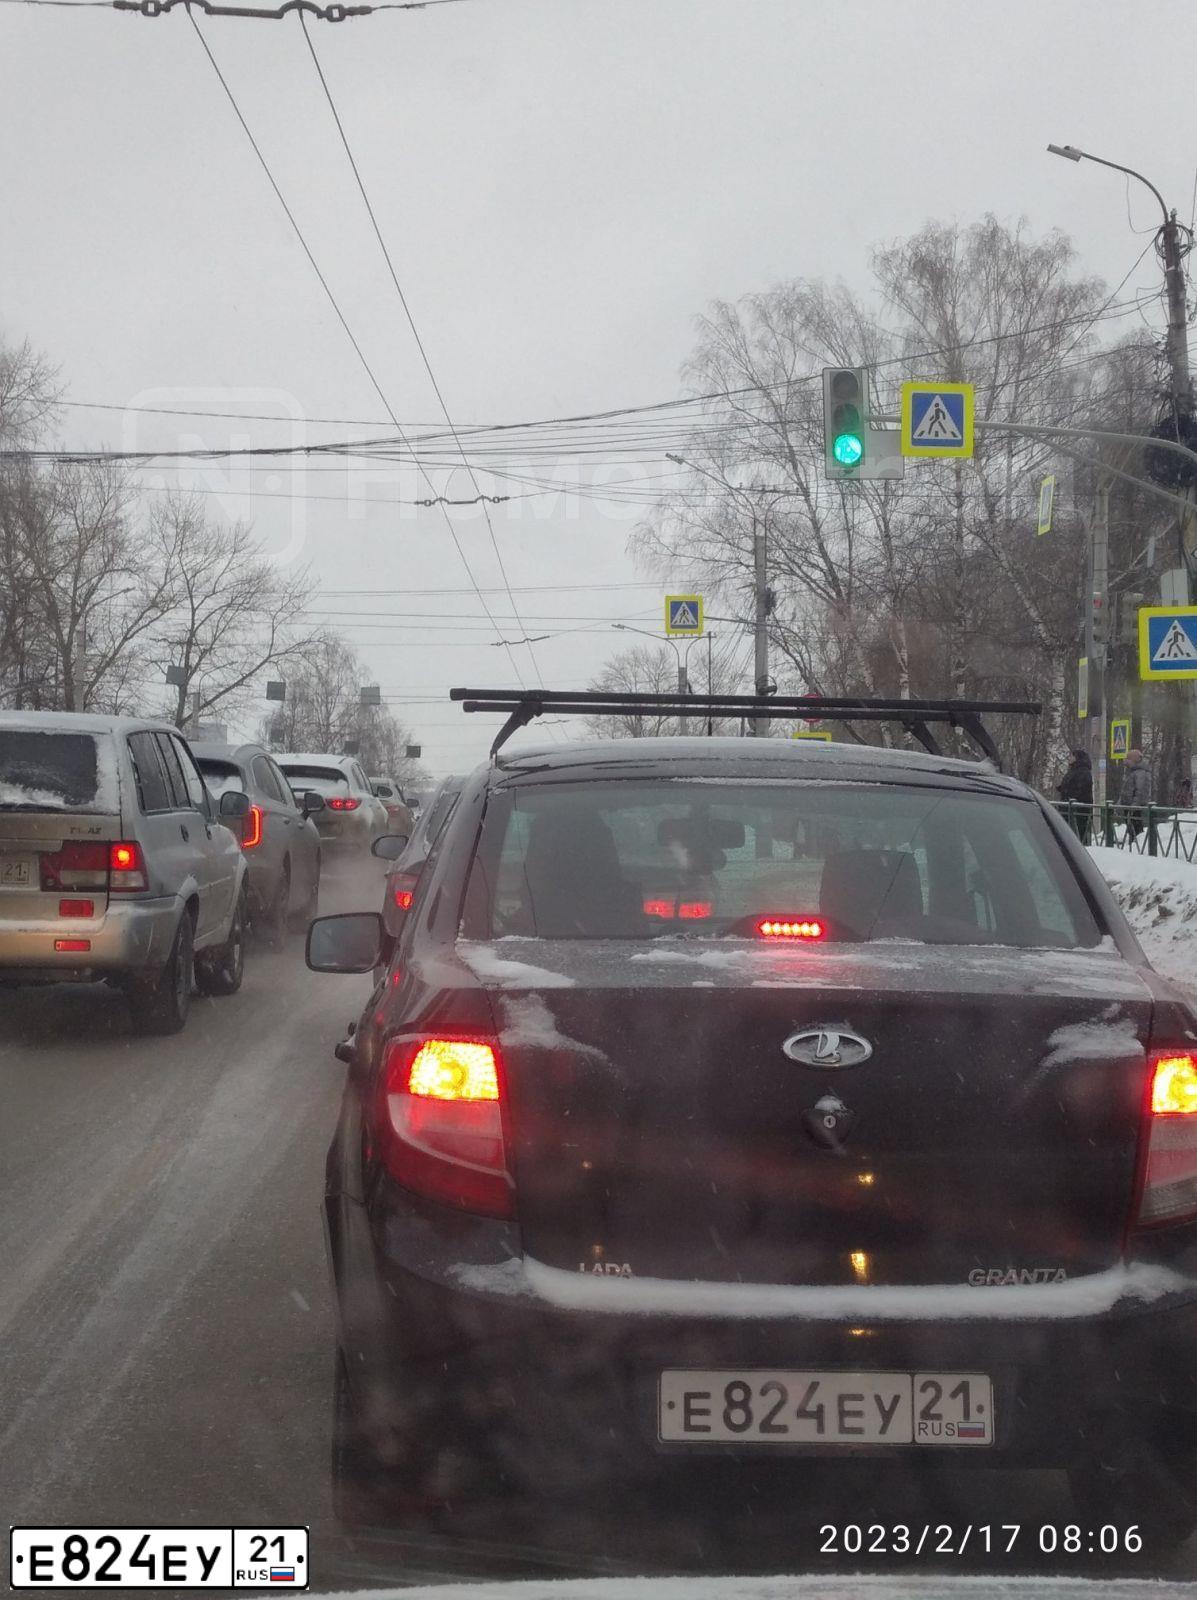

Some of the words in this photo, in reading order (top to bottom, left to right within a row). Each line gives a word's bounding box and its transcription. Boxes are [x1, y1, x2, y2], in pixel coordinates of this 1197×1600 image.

[968, 1268, 1068, 1286] GRANTA
[683, 1380, 901, 1435] Е824ЕУ
[919, 1380, 971, 1421] 21
[917, 1422, 956, 1437] RUS
